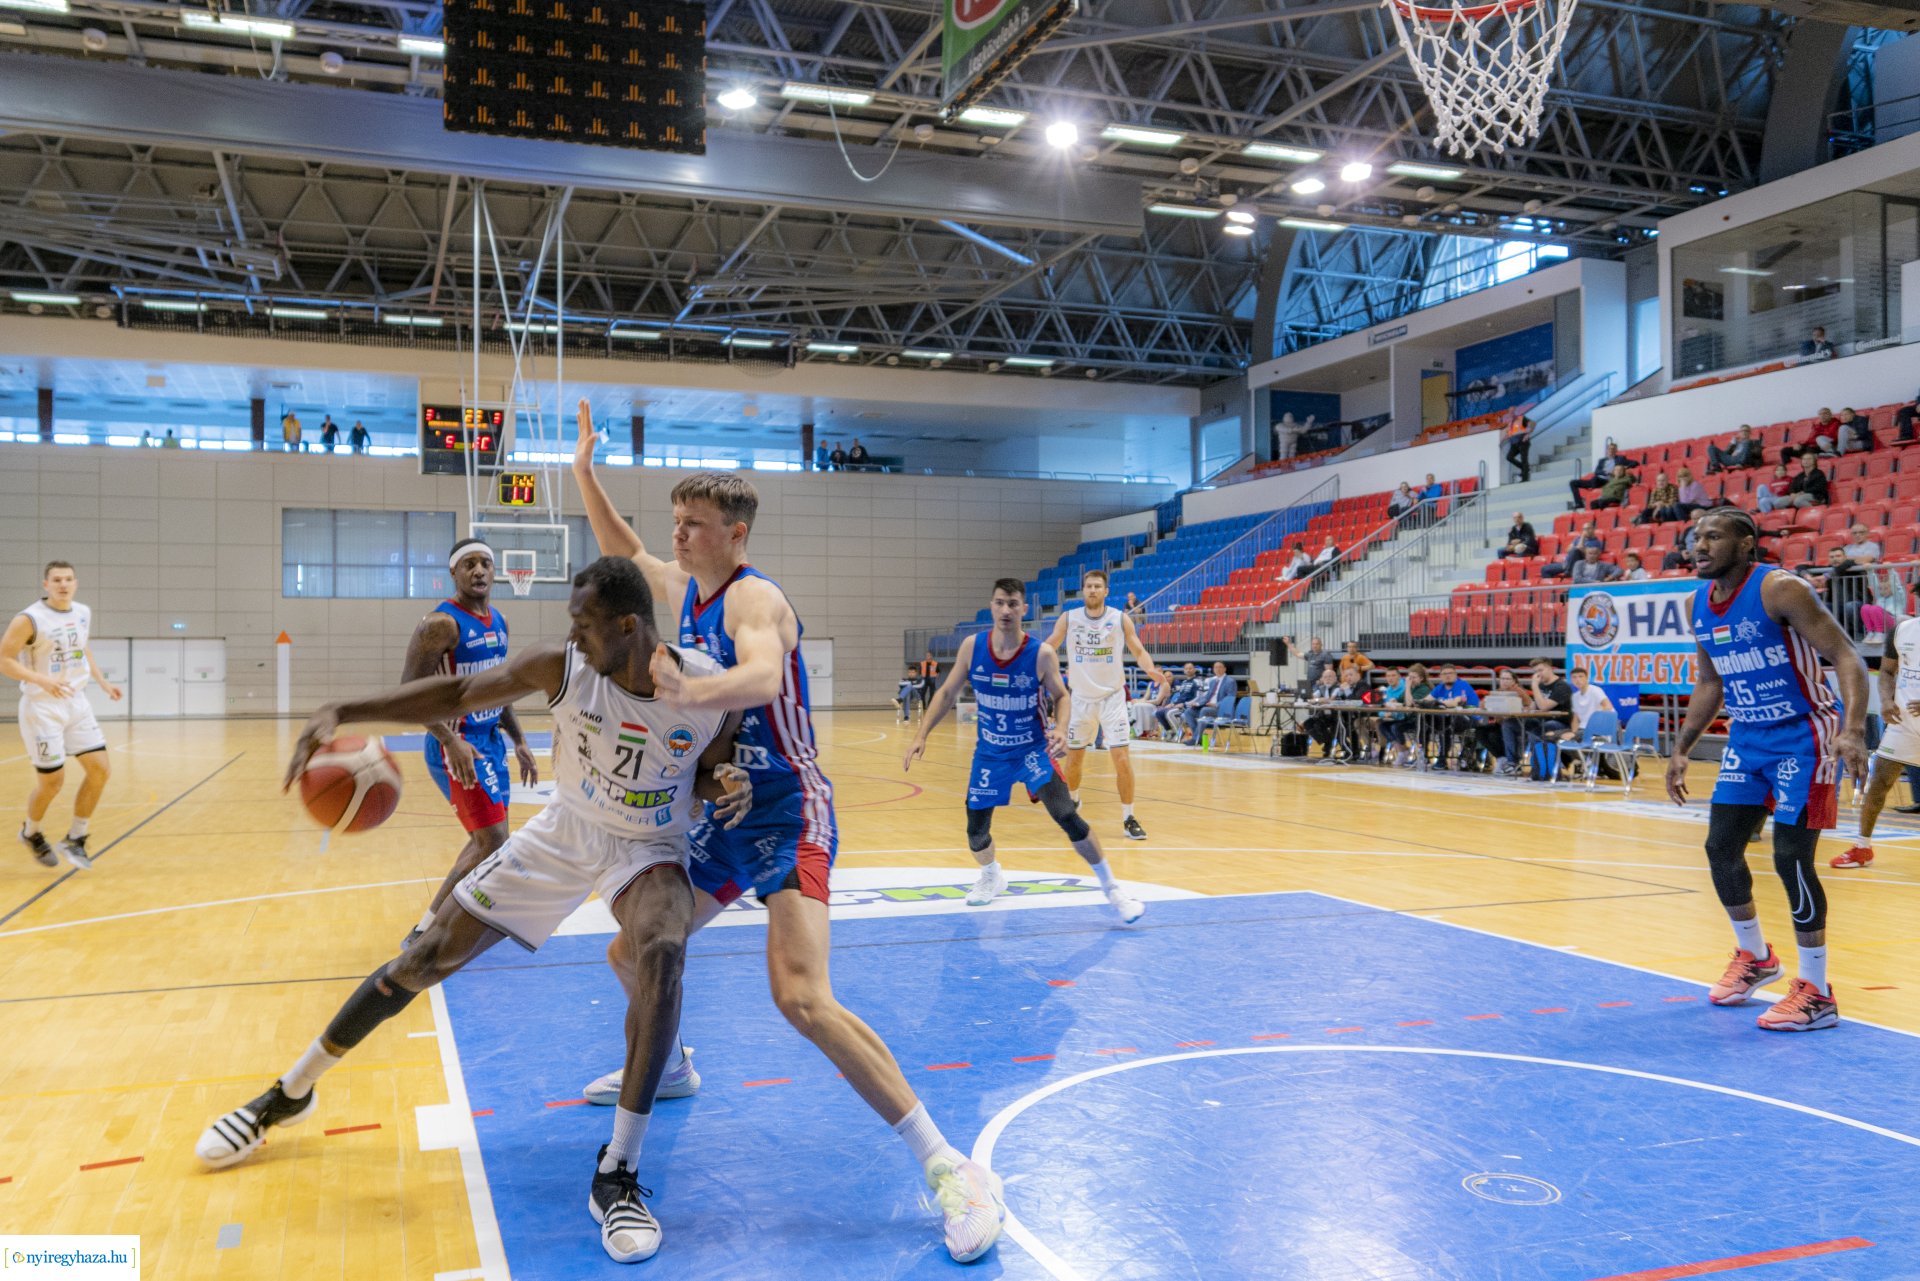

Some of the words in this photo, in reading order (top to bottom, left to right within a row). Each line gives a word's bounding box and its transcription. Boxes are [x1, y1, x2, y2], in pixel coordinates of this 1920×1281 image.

[1628, 600, 1694, 637] HA
[67, 632, 78, 648] 12
[1087, 633, 1101, 645] 35
[1764, 644, 1791, 667] SE
[1729, 679, 1756, 706] 15
[1756, 679, 1788, 691] MVM
[996, 713, 1008, 732] 3
[36, 741, 49, 757] 12
[1720, 746, 1741, 771] 15
[612, 745, 645, 781] 21
[979, 768, 991, 788] 3
